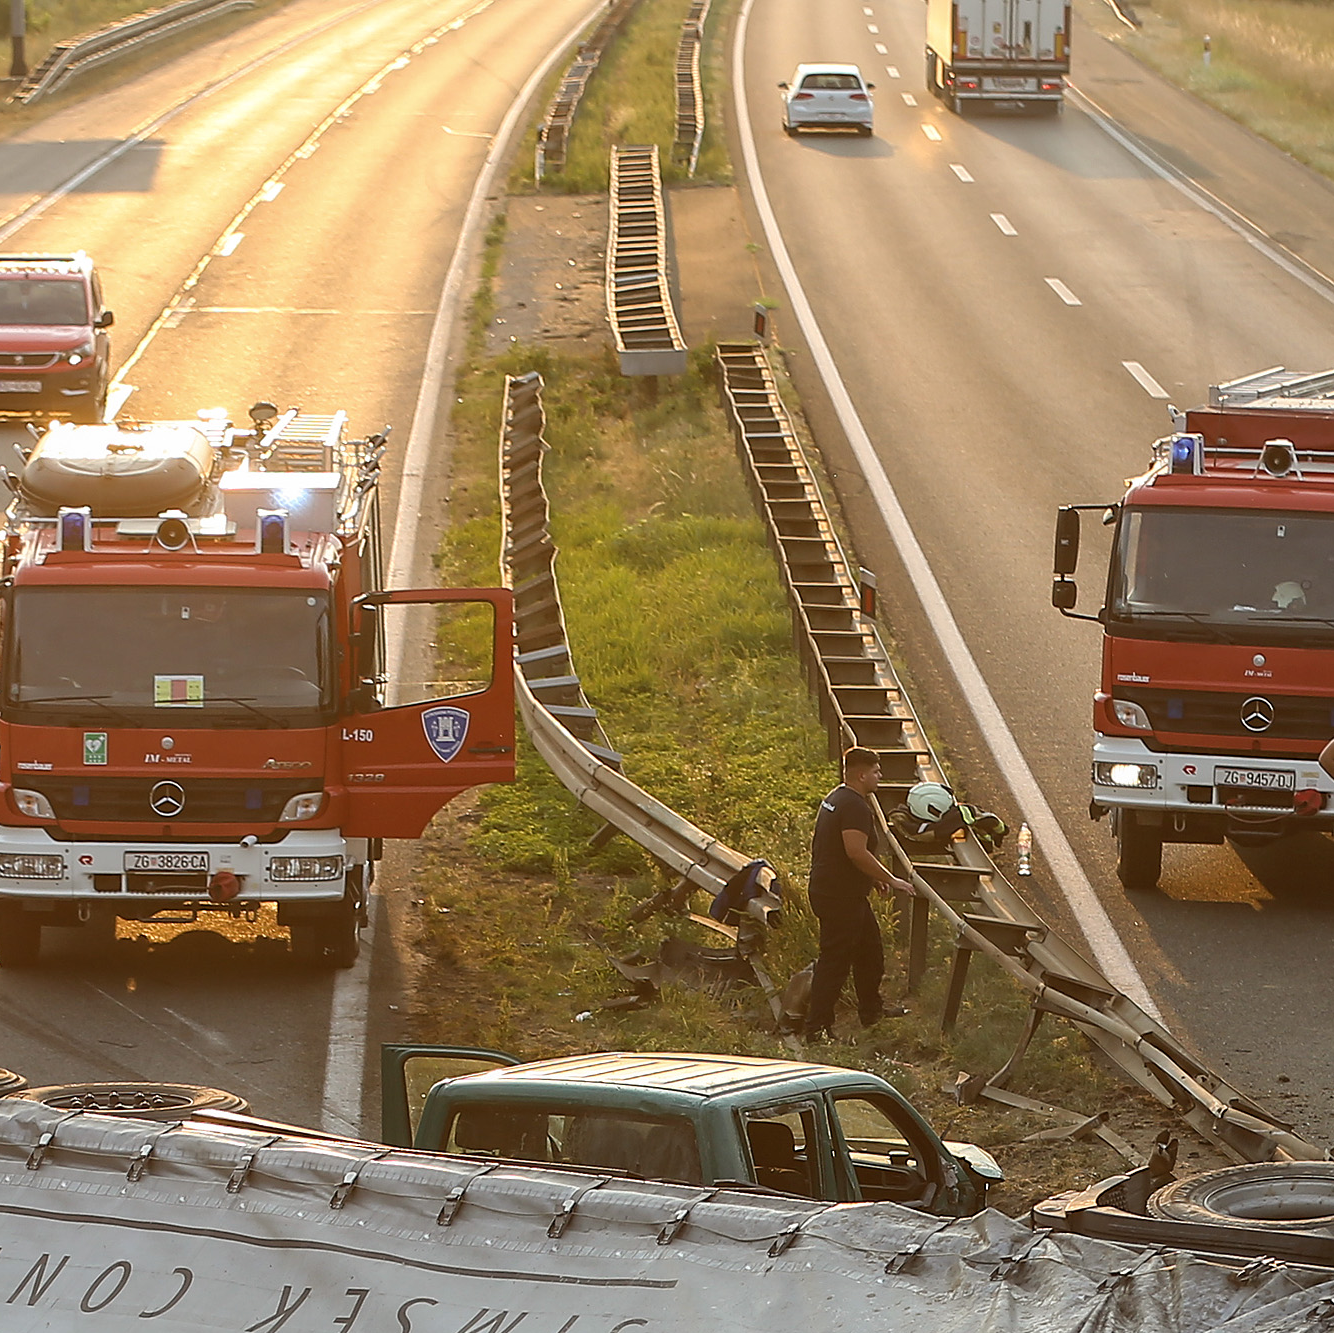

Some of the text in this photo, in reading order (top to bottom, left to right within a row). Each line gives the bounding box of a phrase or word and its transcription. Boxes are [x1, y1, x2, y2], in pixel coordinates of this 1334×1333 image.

[342, 728, 374, 742] L-150
[1224, 770, 1239, 784] ZG
[134, 855, 150, 868] ZG
